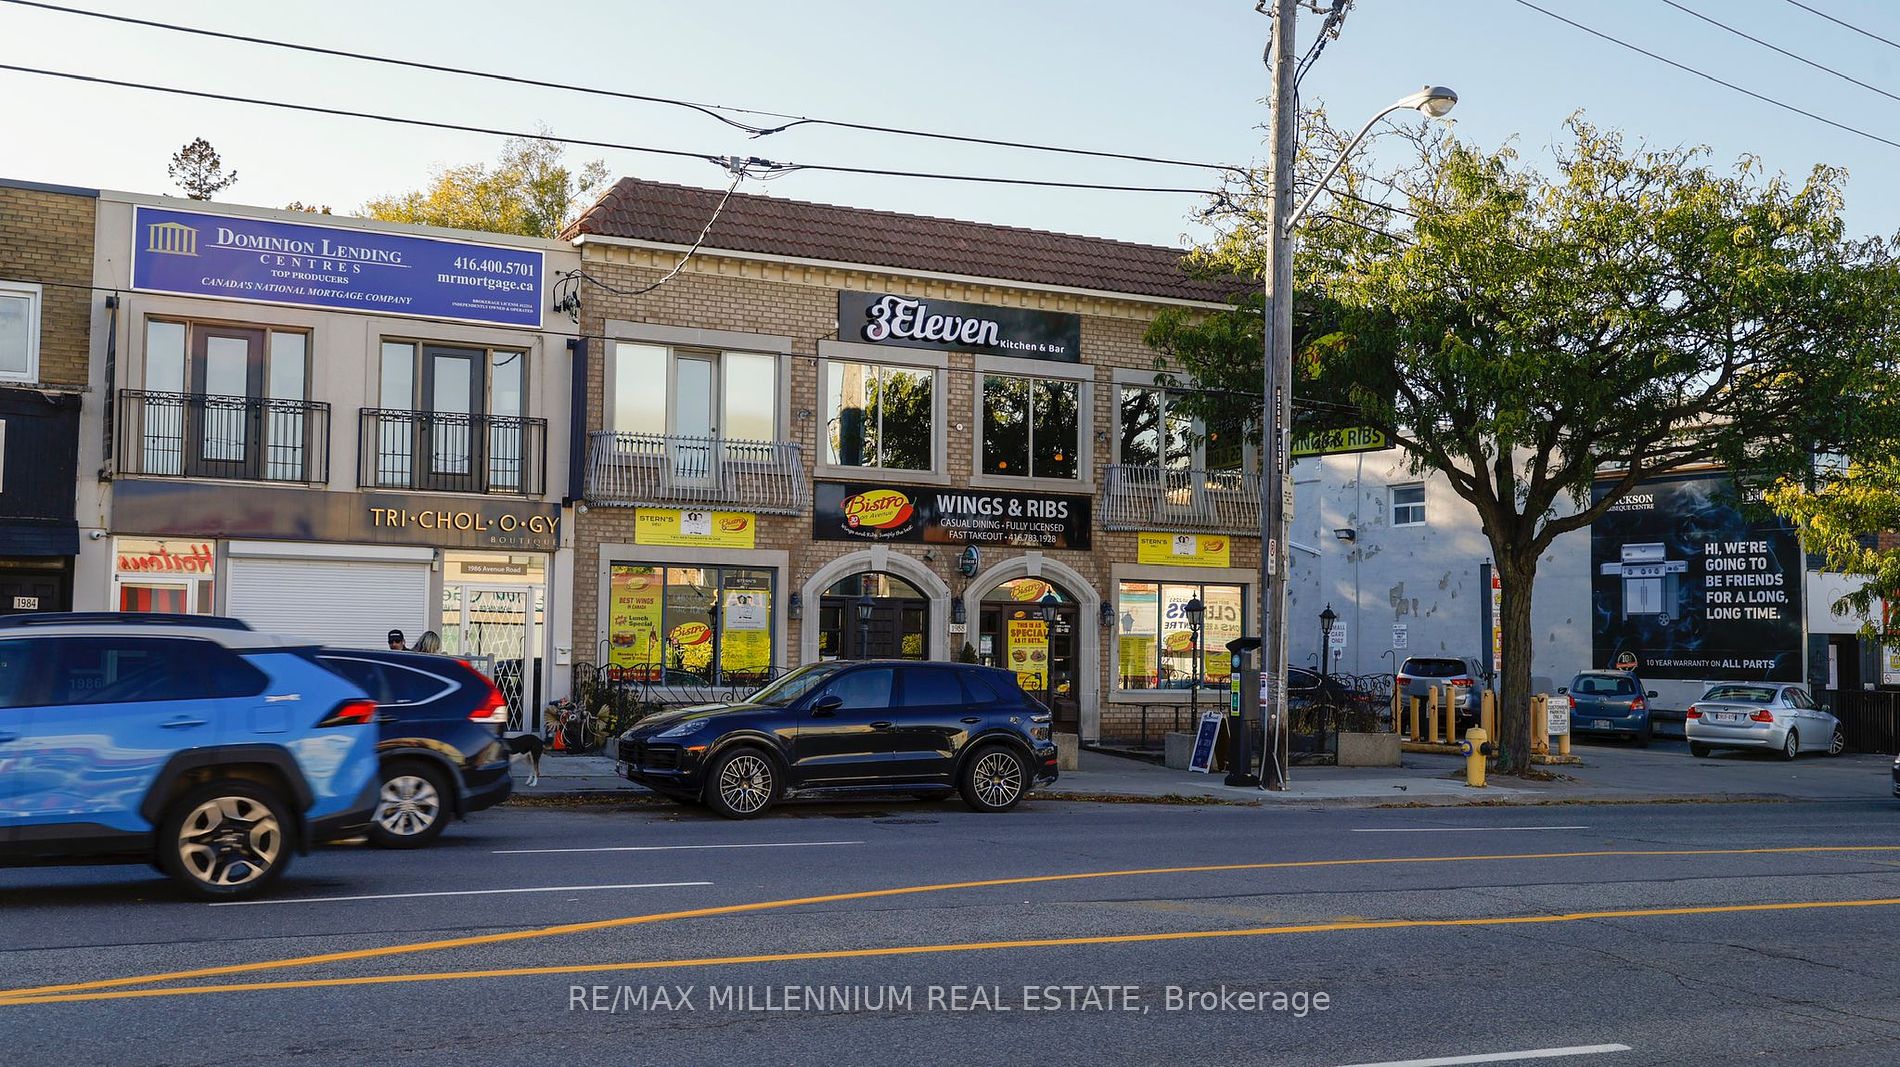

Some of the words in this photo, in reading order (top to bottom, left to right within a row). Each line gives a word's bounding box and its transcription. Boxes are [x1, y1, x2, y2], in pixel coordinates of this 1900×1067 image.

[216, 227, 314, 254] DOMINION
[321, 239, 402, 264] LENDING
[260, 254, 362, 274] CENTRES
[453, 256, 534, 277] 416.400.5701
[271, 269, 290, 278] TOP
[292, 271, 349, 284] PRODUCERS
[437, 273, 534, 292] mrmortgage.ca
[201, 277, 252, 290] CANADA'S
[254, 282, 306, 295] NATIONAL
[307, 288, 363, 300] MORTGAGE
[365, 293, 414, 305] COMPANY
[452, 302, 488, 310] INDEPENDENTLY
[866, 295, 999, 346] 3Eleven
[1000, 339, 1036, 352] Kitchen
[1039, 344, 1046, 352] &
[1049, 344, 1065, 354] Bar
[1348, 428, 1381, 446] RIBS
[845, 494, 904, 515] Bistro
[936, 494, 1004, 517] WINGS
[1008, 499, 1023, 517] &
[1027, 500, 1069, 519] RIBS
[1632, 503, 1655, 511] CENTRE
[639, 515, 674, 523] STERN'S
[940, 518, 971, 529] CASUAL
[973, 520, 1000, 530] DINING
[1006, 522, 1028, 531] FULLY
[1030, 523, 1064, 533] LICENSED
[948, 530, 967, 539] FAST
[968, 531, 1003, 541] TAKEOUT
[1008, 534, 1057, 544] 416.783.1928
[1705, 542, 1722, 555] HI,
[1724, 541, 1768, 554] WE'RE
[483, 565, 505, 573] Avenue
[506, 566, 521, 574] Road
[1705, 557, 1746, 571] GOING
[1748, 557, 1767, 570] TO
[1705, 575, 1723, 587] BE
[1725, 573, 1784, 587] FRIENDS
[16, 598, 36, 608] 1984
[635, 597, 654, 605] WINGS
[1706, 591, 1732, 604] FOR
[1735, 591, 1746, 603] A
[1749, 590, 1789, 604] LONG,
[1706, 607, 1741, 620] LONG
[1744, 607, 1781, 620] TIME.
[670, 626, 705, 641] Bistro
[1010, 628, 1049, 638] SPECIAL
[1655, 659, 1672, 667] YEAR
[1722, 659, 1741, 668] ALL
[1743, 659, 1776, 669] PARTS
